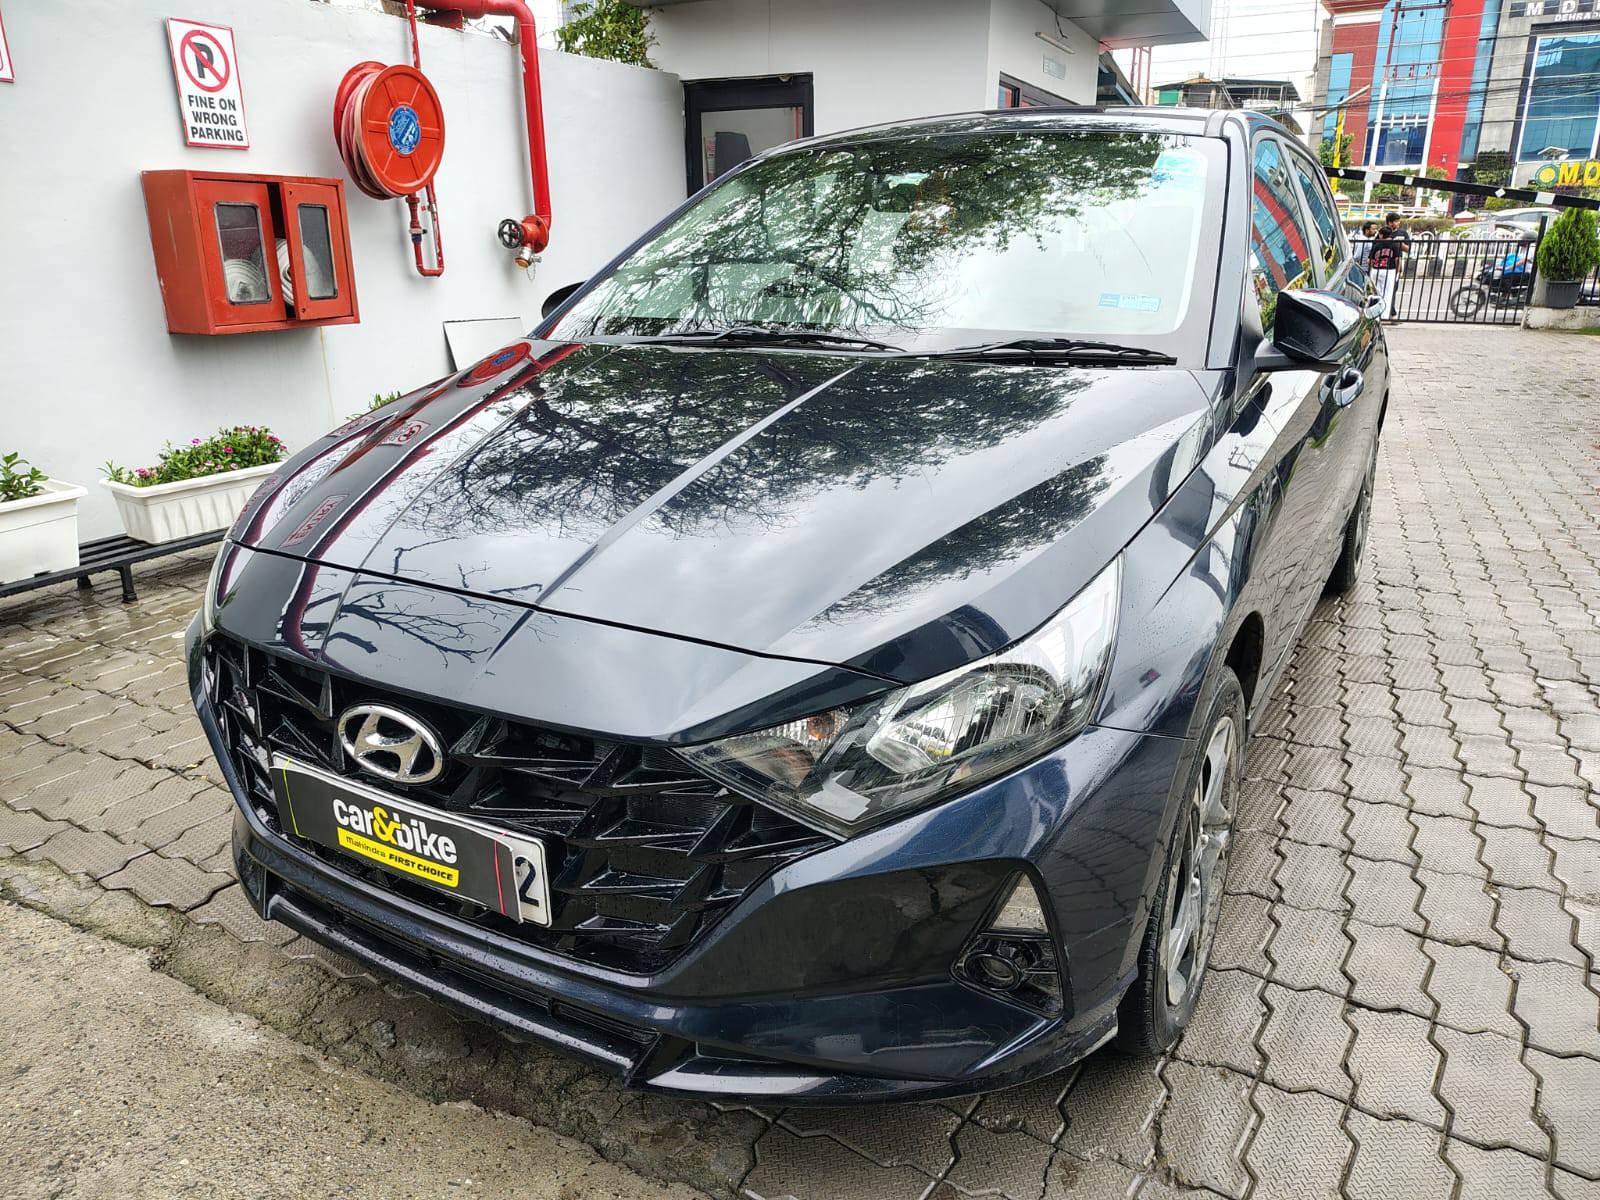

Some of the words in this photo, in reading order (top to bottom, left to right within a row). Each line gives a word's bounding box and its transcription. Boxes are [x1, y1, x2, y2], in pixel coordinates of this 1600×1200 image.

[1554, 11, 1600, 22] DEHRAD
[188, 95, 216, 109] FINE
[219, 98, 236, 111] ON
[192, 111, 237, 126] WRONG
[191, 127, 244, 141] PARKING
[332, 798, 458, 864] car&bike
[388, 853, 416, 869] FIRST
[417, 863, 454, 881] CHOICE
[514, 856, 540, 908] 2
